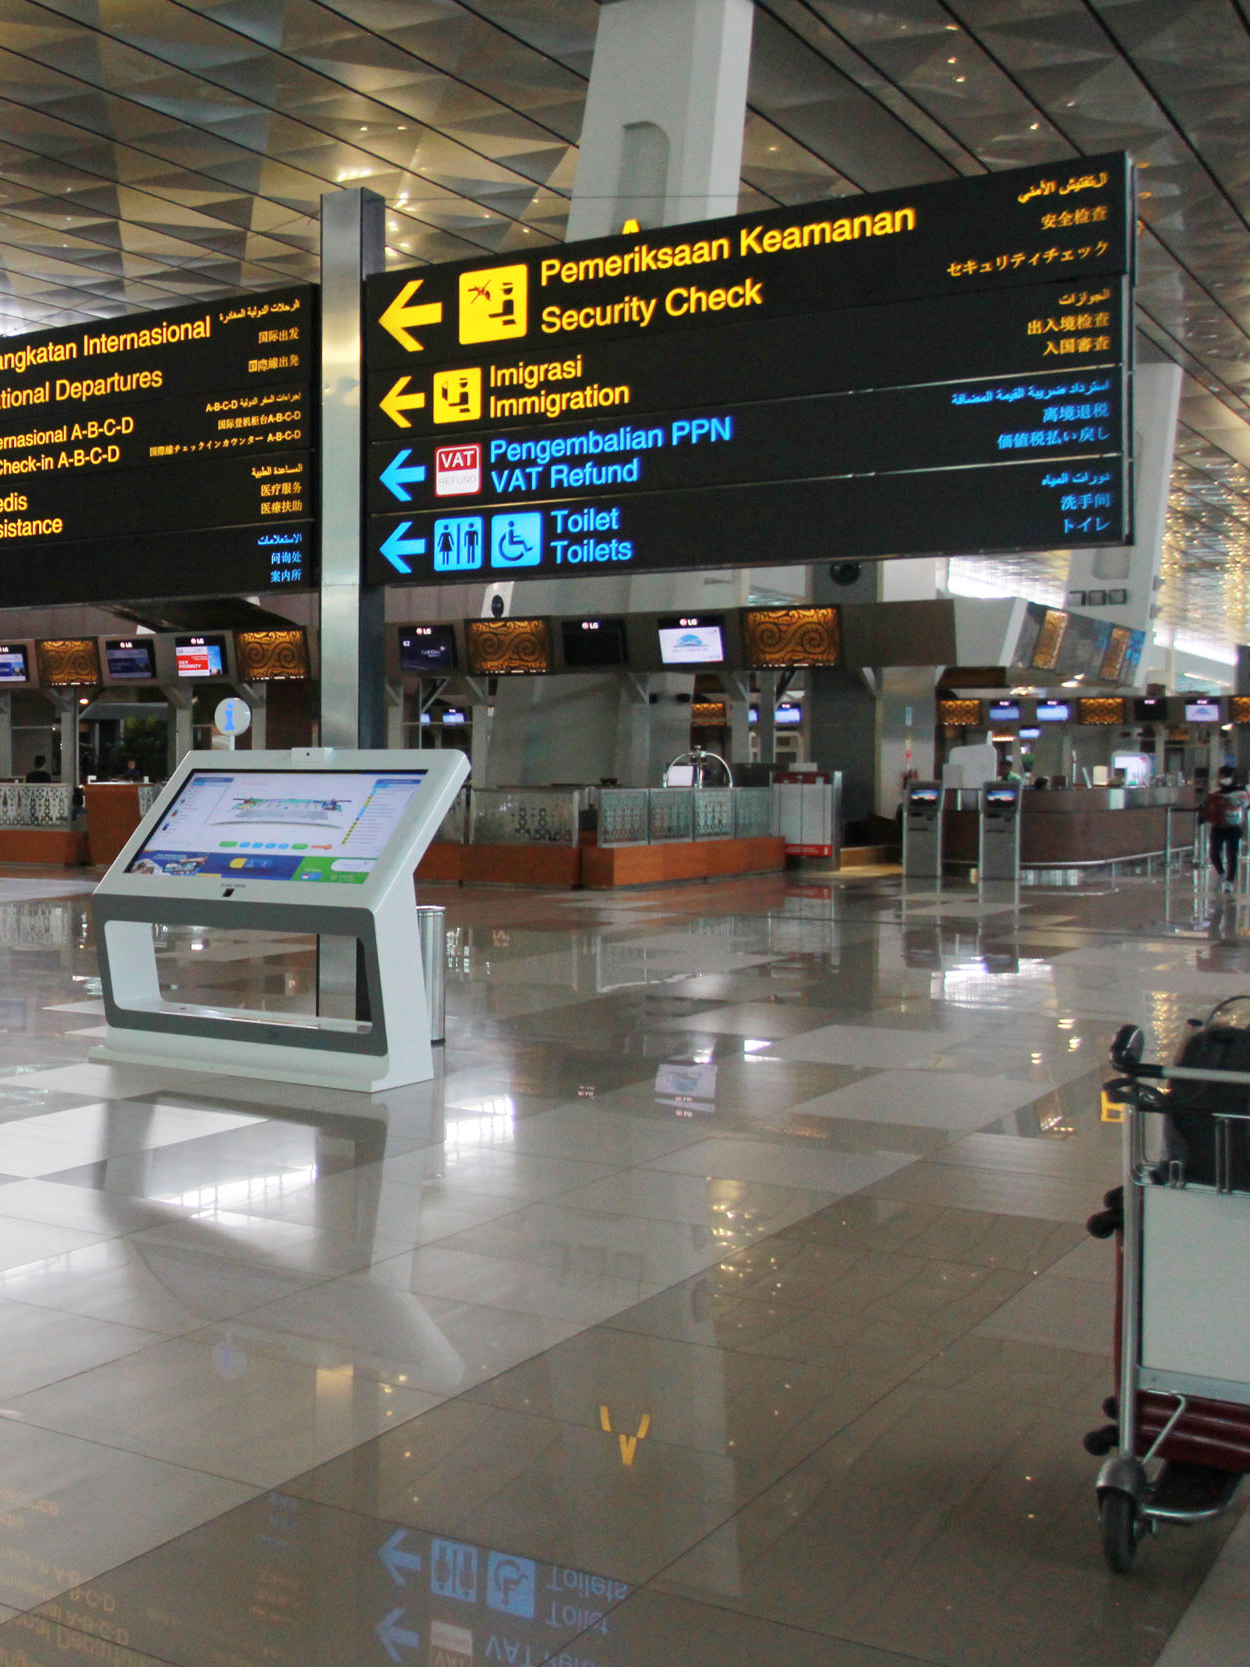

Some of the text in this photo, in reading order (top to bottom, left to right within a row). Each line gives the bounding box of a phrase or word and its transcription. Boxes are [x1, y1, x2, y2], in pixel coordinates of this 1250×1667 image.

[541, 208, 916, 286] Pemeriksaan Keamanan
[947, 241, 1109, 276] セキュリティチェック
[541, 278, 763, 333] Security Check
[84, 315, 211, 356] Internasional
[56, 370, 163, 401] Departures
[490, 354, 582, 389] Imigrasi
[206, 400, 238, 412] A-B-C-D
[490, 384, 630, 418] Immigration
[71, 416, 134, 440] A-B-C-D
[267, 430, 301, 442] A-B-C-D
[491, 416, 734, 466] Pengembalian PPN
[57, 445, 120, 468] A-B-C-D
[441, 450, 475, 468] VAT
[491, 456, 641, 493] VAT Refund
[550, 507, 621, 534] Toilet
[1063, 517, 1110, 534] トイレ
[550, 538, 634, 564] Toilets
